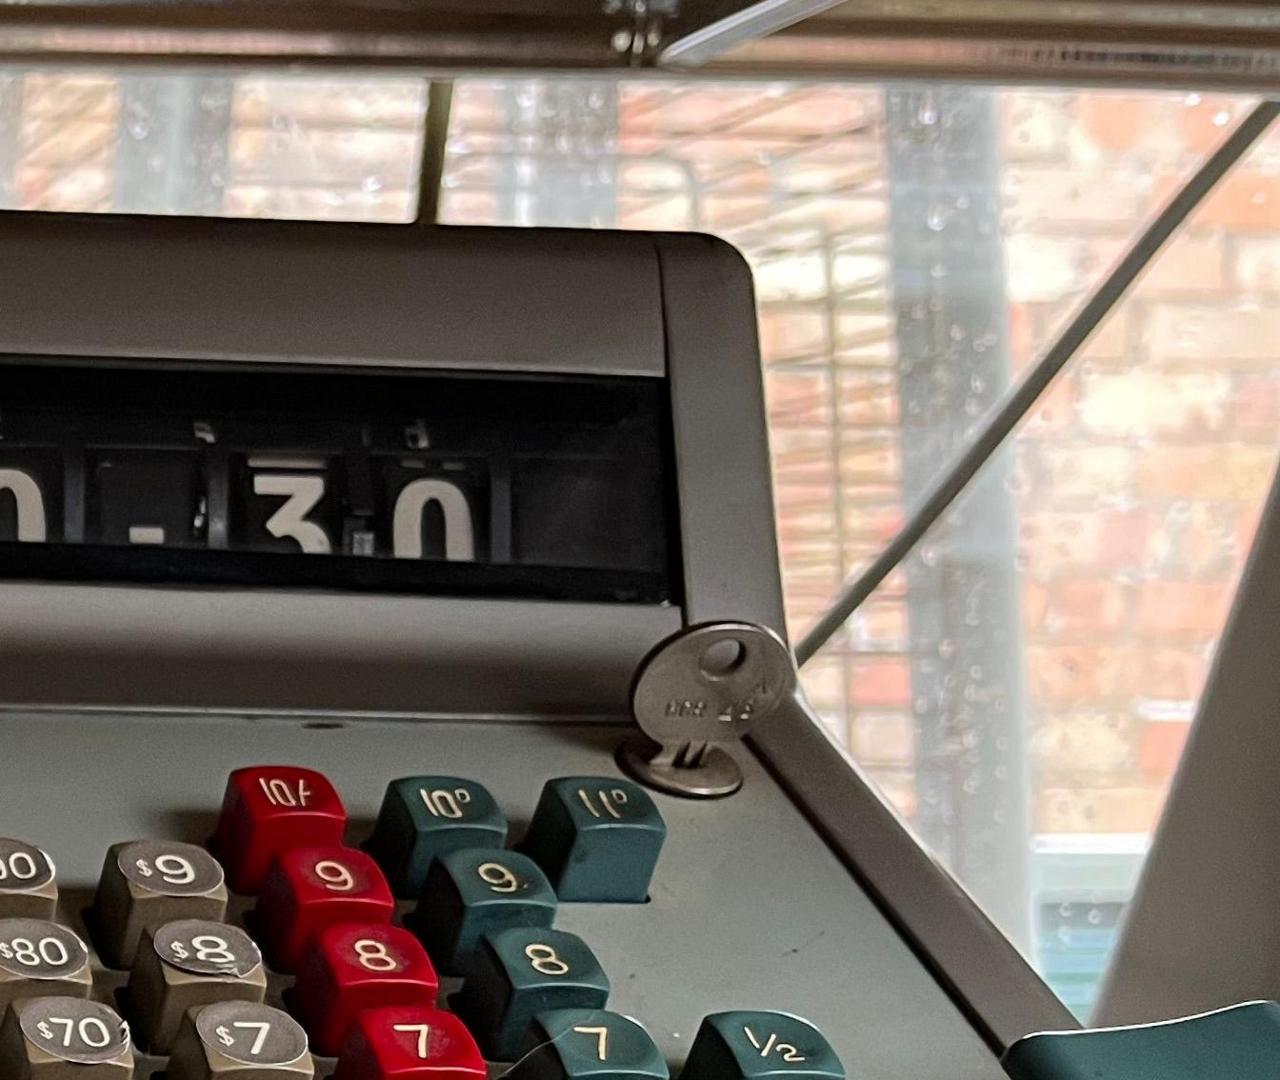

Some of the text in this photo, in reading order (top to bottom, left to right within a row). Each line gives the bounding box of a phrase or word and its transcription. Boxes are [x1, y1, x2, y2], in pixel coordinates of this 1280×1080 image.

[135, 854, 196, 884] $9
[315, 860, 354, 891] 9
[477, 862, 518, 893] 9
[170, 935, 236, 968] $8
[354, 939, 397, 971] 8
[524, 943, 569, 975] 8
[36, 1017, 111, 1047] $70
[215, 1021, 271, 1059] $7
[393, 1024, 429, 1058] 7
[573, 1026, 608, 1061] 7
